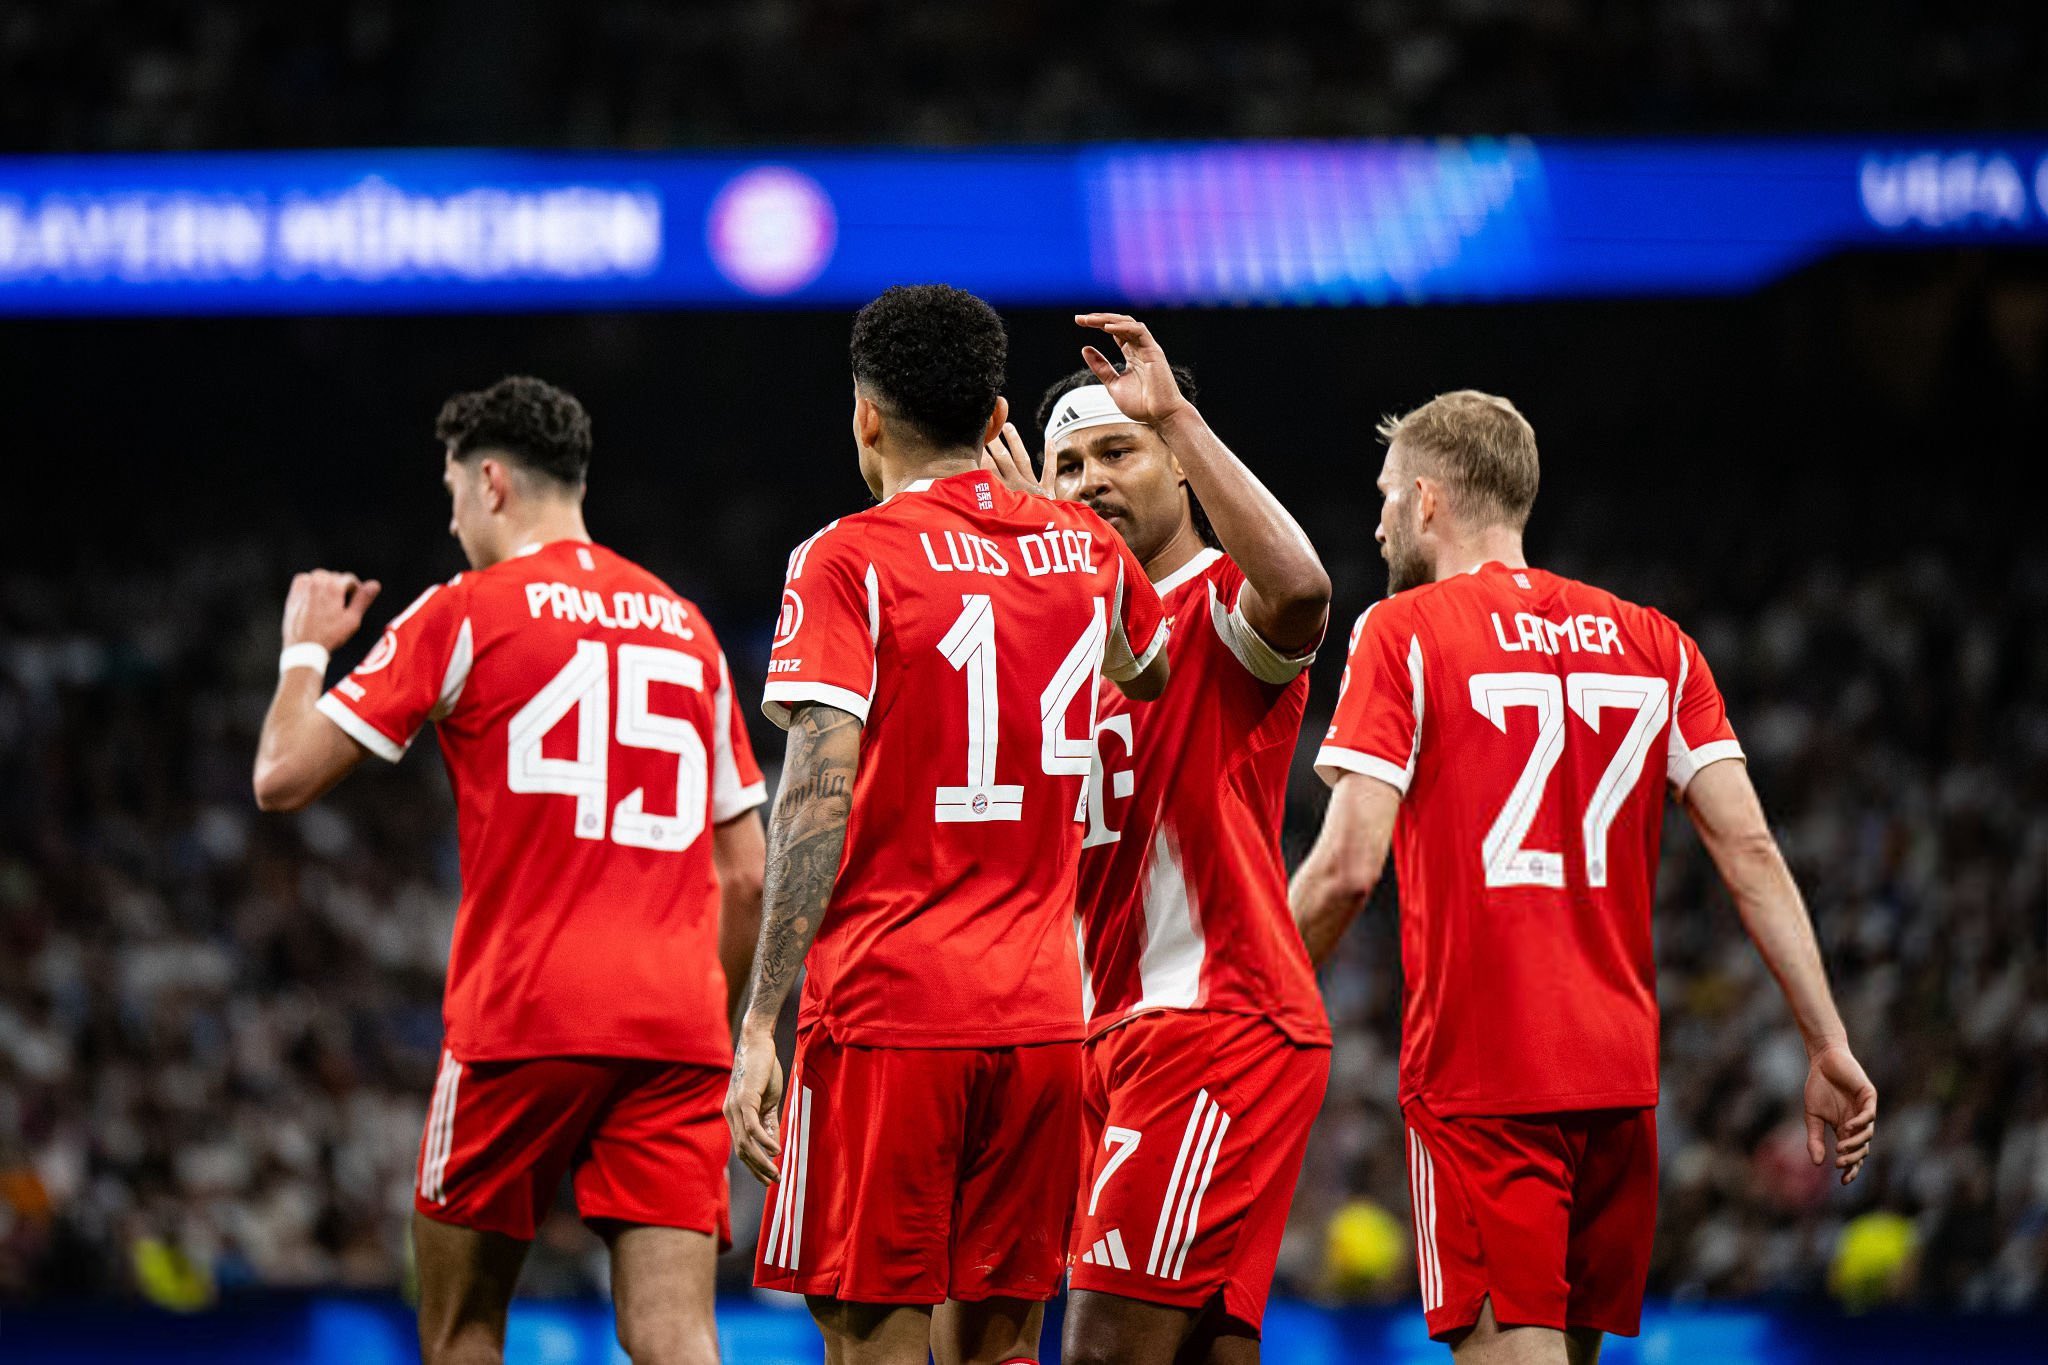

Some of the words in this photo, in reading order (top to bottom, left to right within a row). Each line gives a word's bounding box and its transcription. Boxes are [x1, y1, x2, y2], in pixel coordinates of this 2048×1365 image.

[975, 483, 990, 492] MIA
[976, 492, 992, 501] SAN
[978, 501, 993, 510] MIA
[919, 531, 1009, 577] LUIS
[1016, 522, 1098, 577] DÍAZ
[935, 594, 1106, 822] 14
[507, 640, 709, 852] 45
[1468, 672, 1669, 888] 27
[1088, 1126, 1142, 1216] 7
